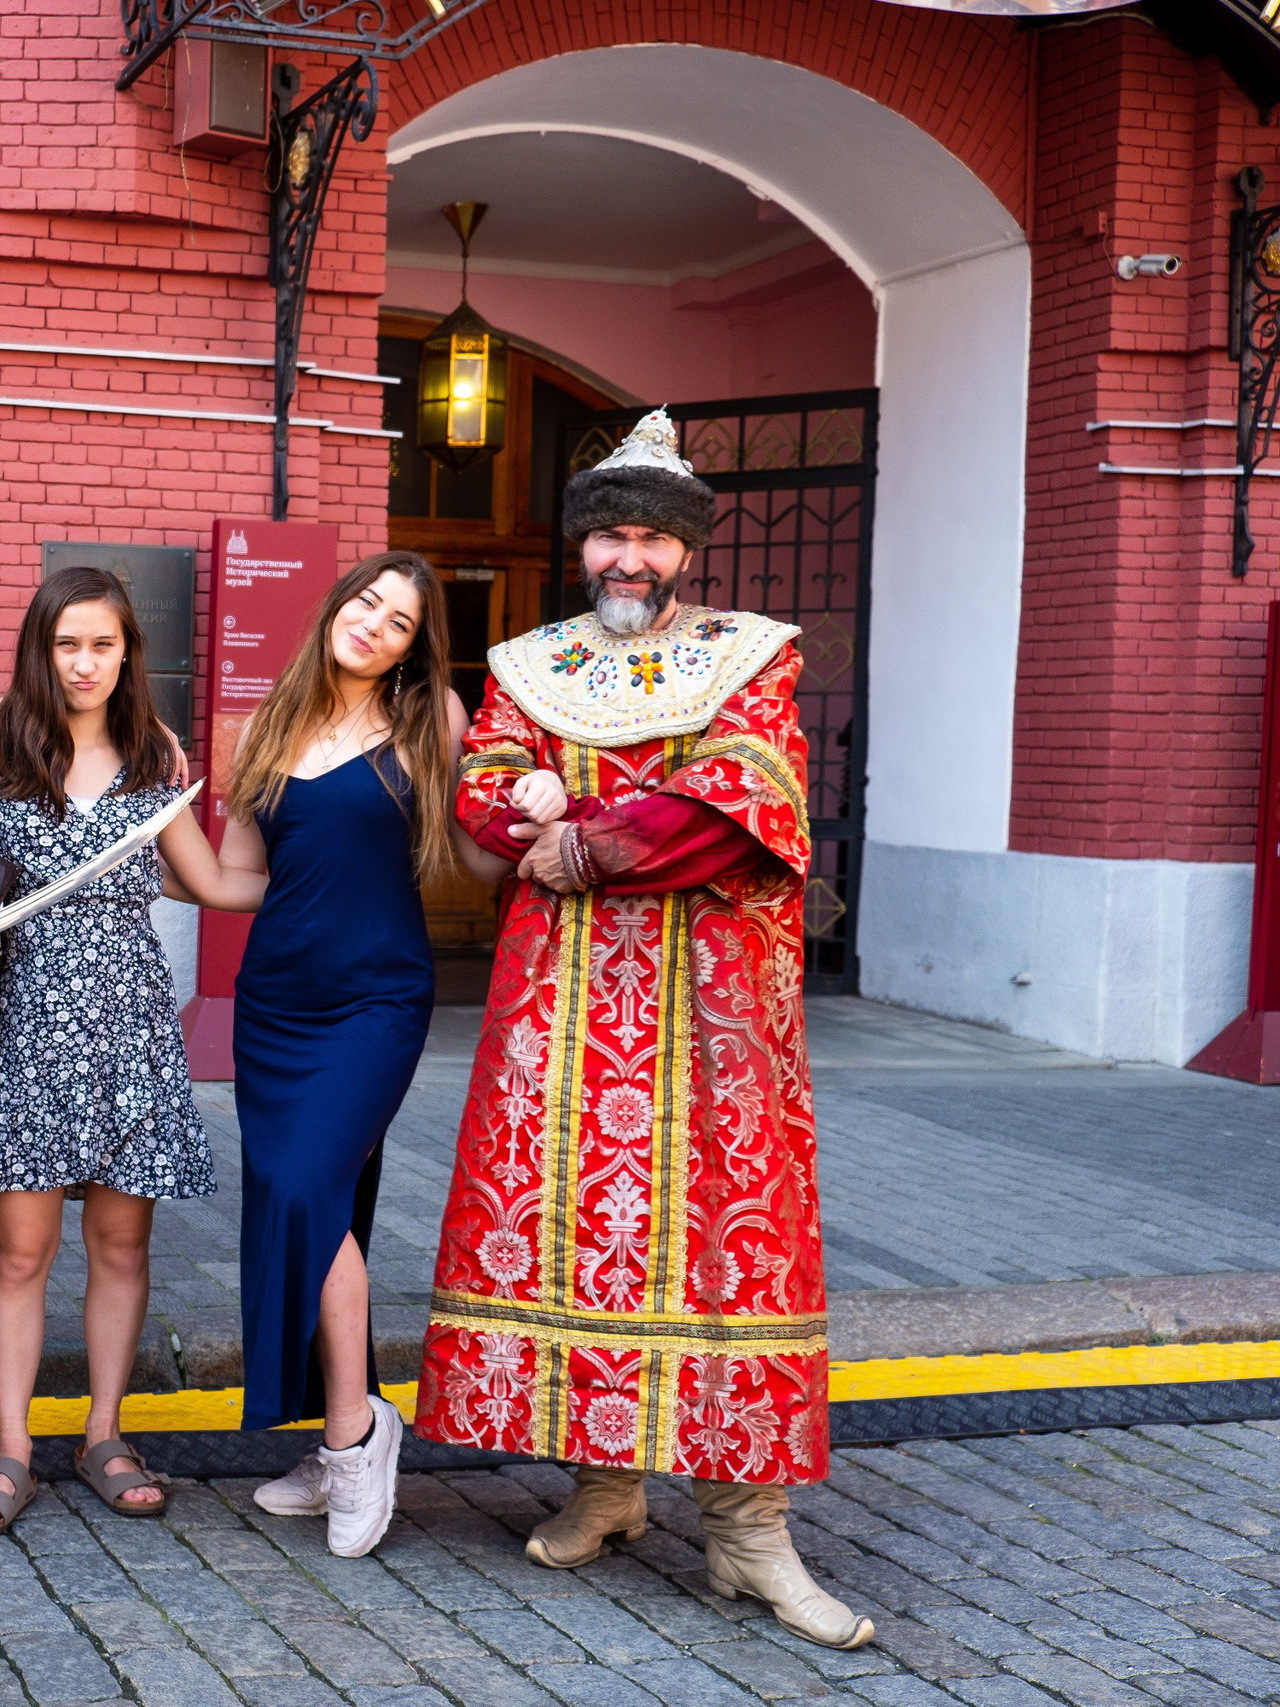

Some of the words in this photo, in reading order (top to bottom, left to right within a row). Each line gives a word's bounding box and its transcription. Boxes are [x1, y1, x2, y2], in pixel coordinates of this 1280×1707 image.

[226, 557, 302, 569] Государственный
[225, 567, 289, 578] Исторический
[225, 578, 252, 587] музей
